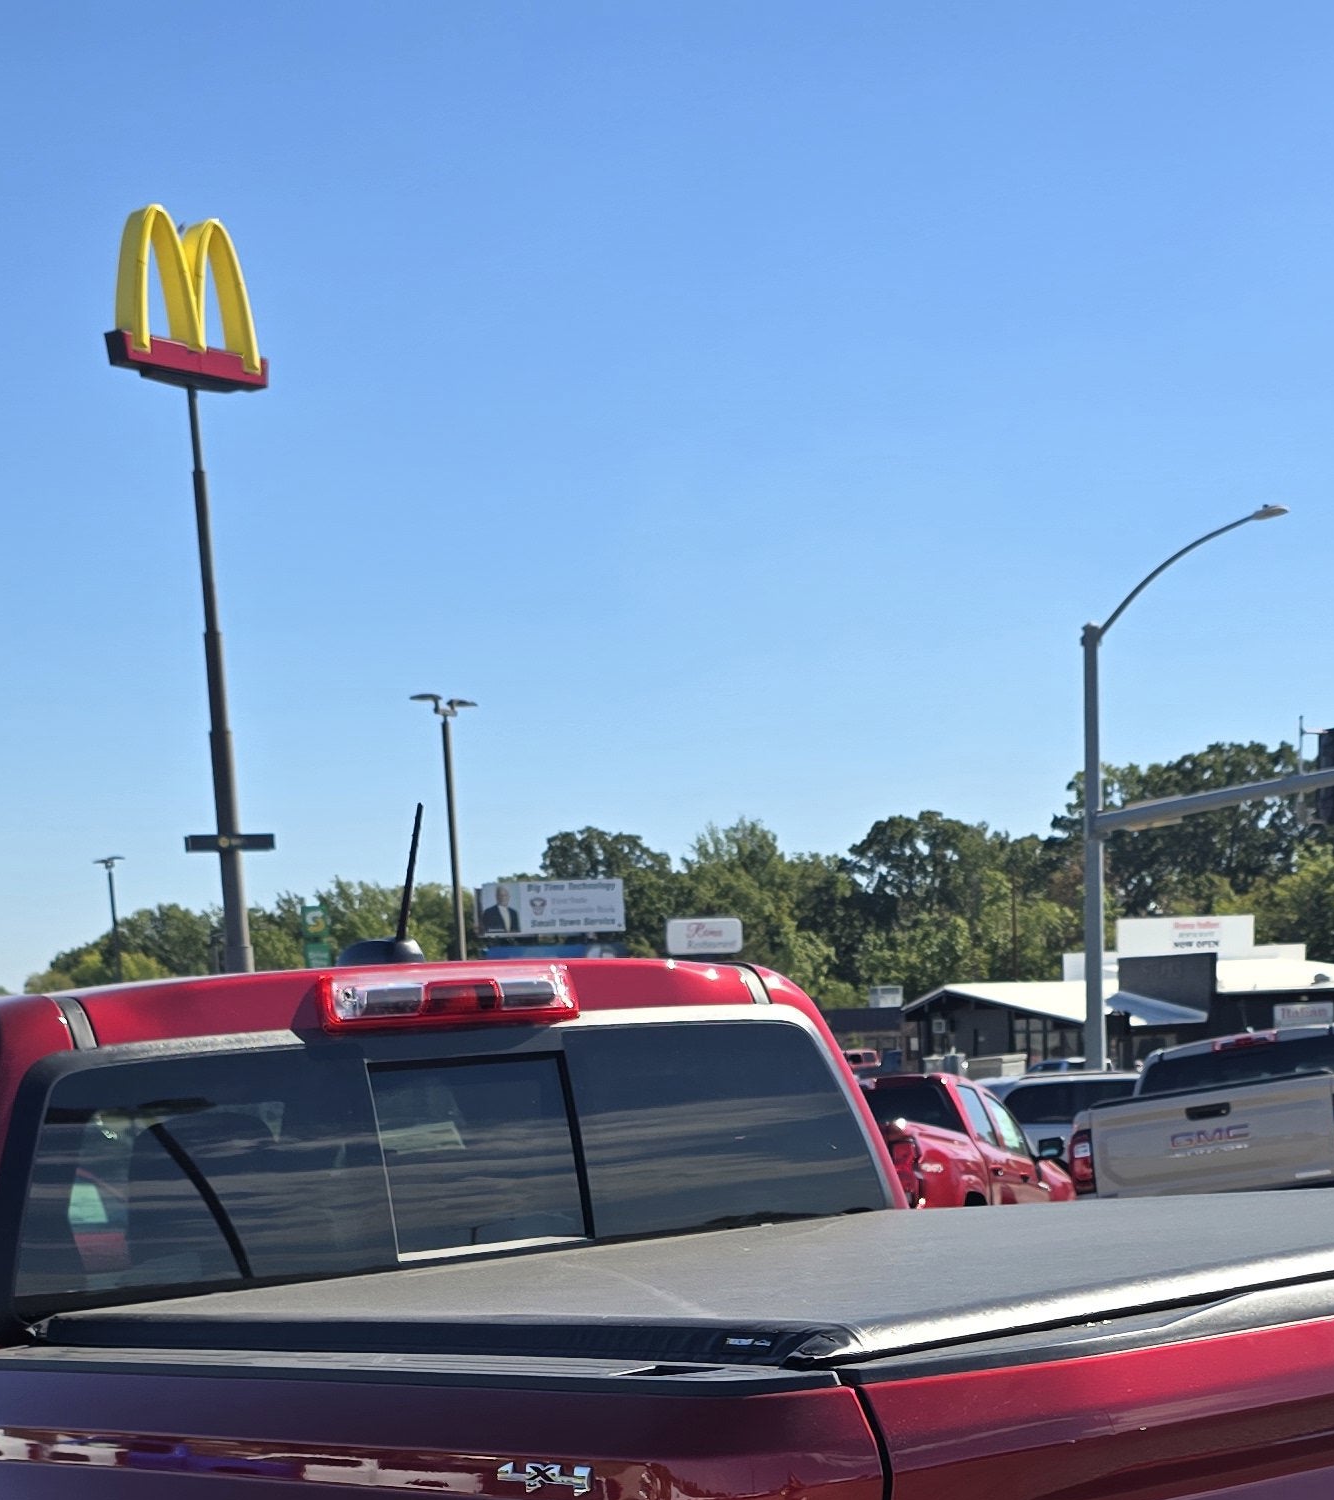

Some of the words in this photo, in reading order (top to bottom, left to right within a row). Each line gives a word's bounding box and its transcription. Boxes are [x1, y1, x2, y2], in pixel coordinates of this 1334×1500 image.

[1174, 940, 1194, 949] NOW
[1196, 940, 1219, 949] OPEN
[1170, 1123, 1252, 1148] GMC
